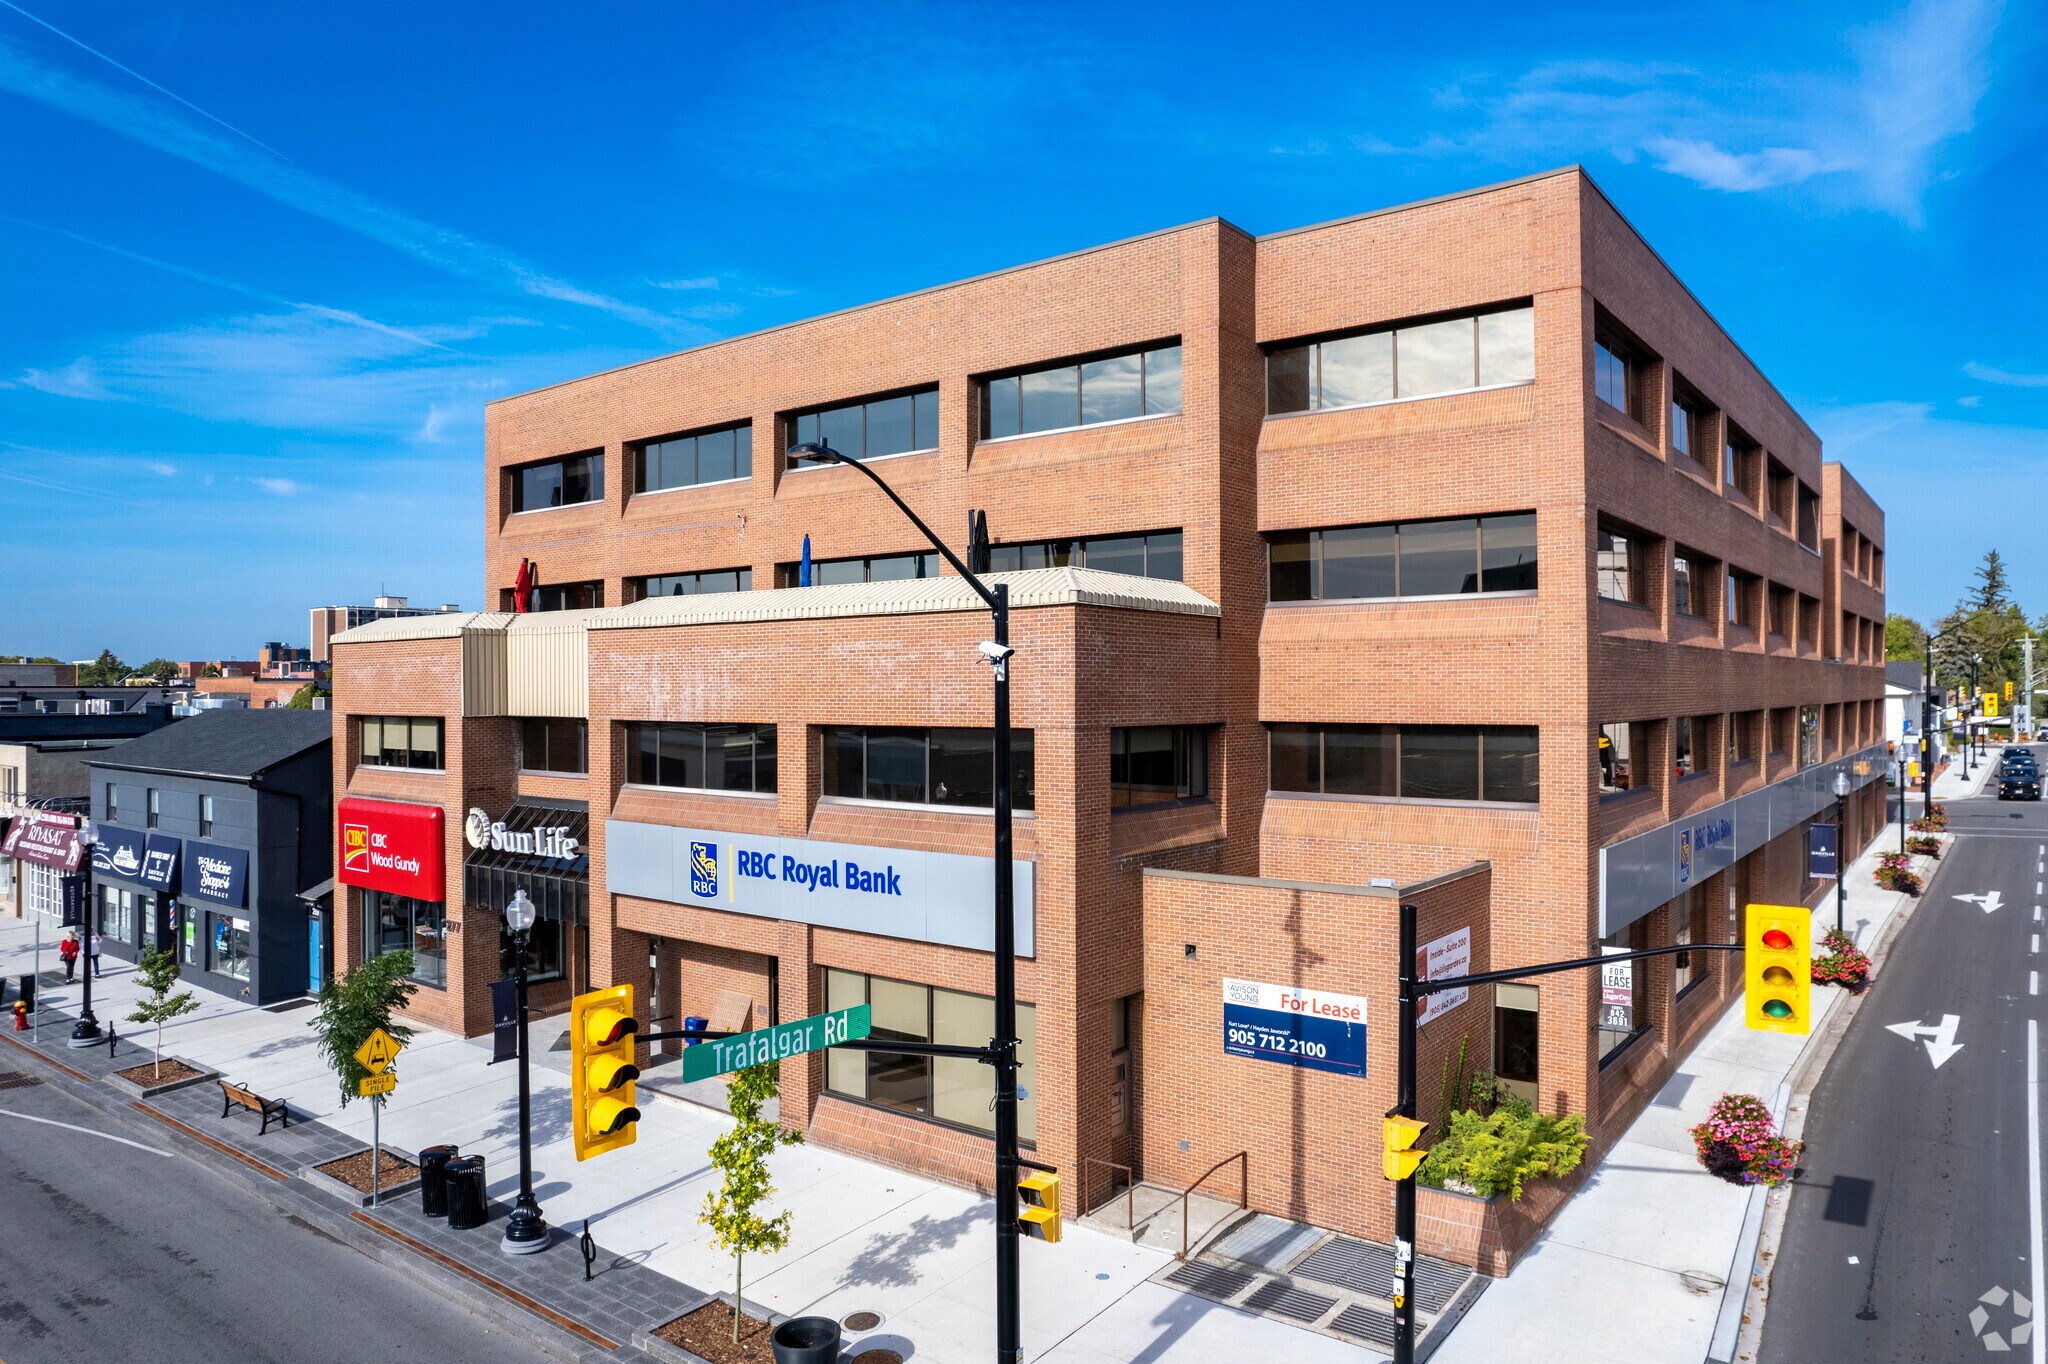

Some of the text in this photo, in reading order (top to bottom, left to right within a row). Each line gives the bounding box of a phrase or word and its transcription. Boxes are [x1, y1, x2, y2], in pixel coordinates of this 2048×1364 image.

[28, 826, 66, 846] RIYASAT
[346, 829, 366, 848] CIBC
[371, 833, 387, 848] CIBC
[491, 821, 579, 860] Sun Life
[203, 857, 232, 875] Medicine
[371, 851, 420, 876] Wood Gundy
[738, 850, 902, 896] RBC Royal Bank
[200, 888, 229, 899] PHARMACY
[693, 880, 716, 895] RBC
[1446, 942, 1458, 954] Suite
[1457, 937, 1467, 948] 200
[1609, 967, 1625, 976] FOR
[1603, 975, 1631, 988] LEASE
[1229, 984, 1259, 995] AVISON
[1230, 991, 1259, 1003] YOUNG
[1603, 992, 1632, 1001] LisgarDev
[1281, 993, 1361, 1020] For Lease
[1607, 1016, 1628, 1027] 3691
[713, 1010, 848, 1074] Trafalgar Rd
[1228, 1028, 1327, 1058] 905 712 2100
[365, 1076, 390, 1087] SINGLE
[370, 1084, 385, 1092] FILE
